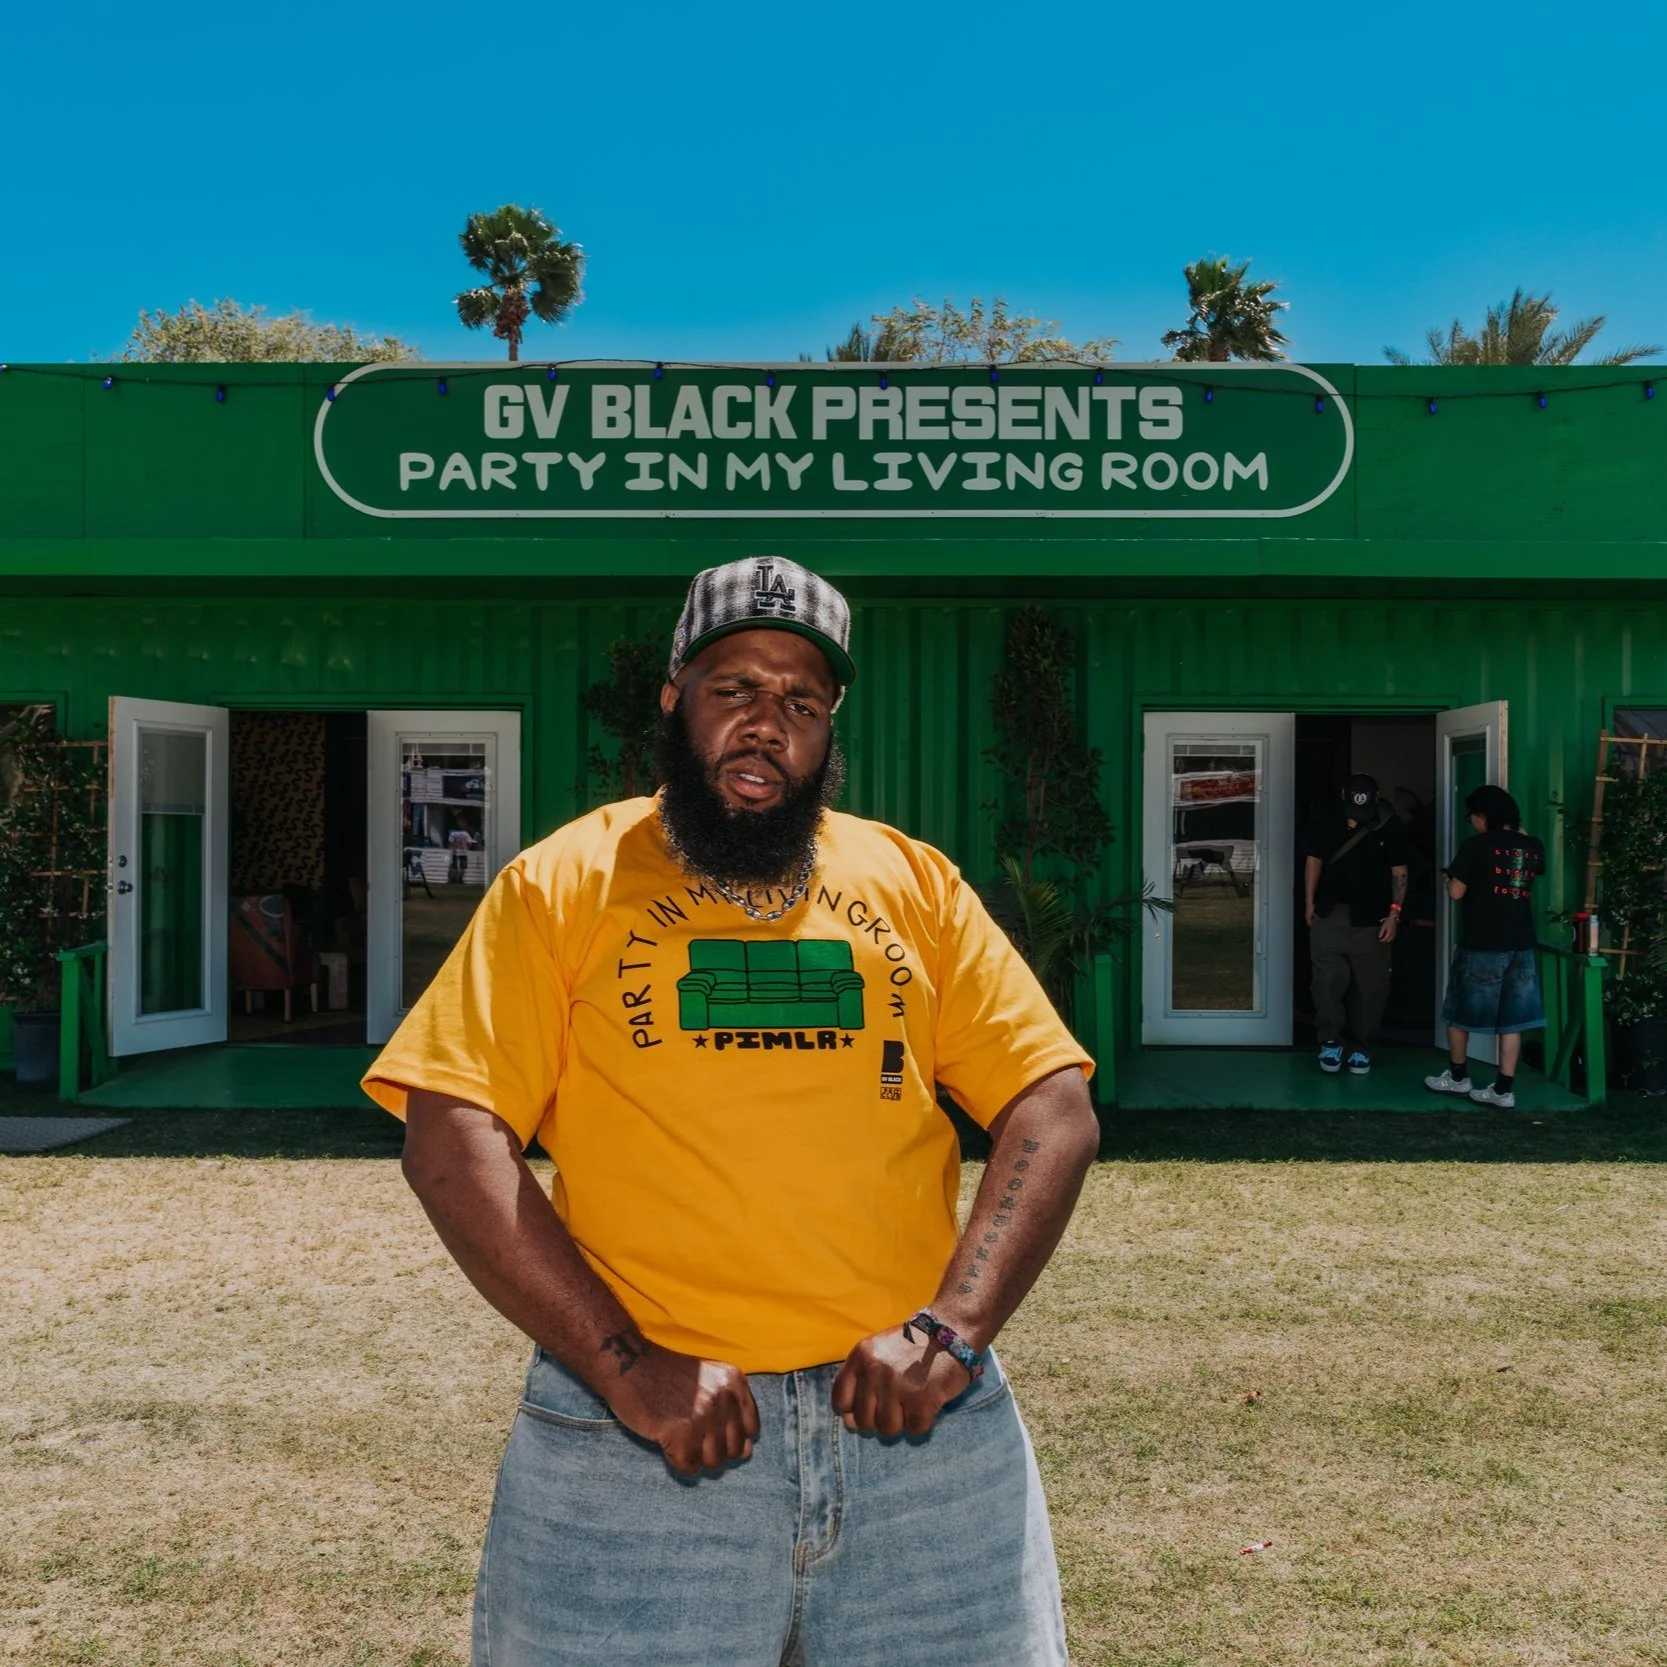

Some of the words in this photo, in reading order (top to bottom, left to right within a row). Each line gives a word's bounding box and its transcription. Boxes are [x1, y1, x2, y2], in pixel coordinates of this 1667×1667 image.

[484, 385, 570, 439] GV
[591, 385, 798, 439] BLACK
[812, 386, 1183, 440] PRESENTS
[400, 452, 606, 491] PARTY
[625, 452, 708, 491] IN
[726, 452, 814, 491] MY
[832, 452, 1083, 491] LIVING
[1102, 452, 1268, 491] ROOM
[756, 565, 796, 611] LA
[618, 930, 662, 1049] PARTY
[647, 895, 690, 928] IN
[864, 917, 912, 1018] ROOM
[714, 1031, 837, 1051] PIMLR
